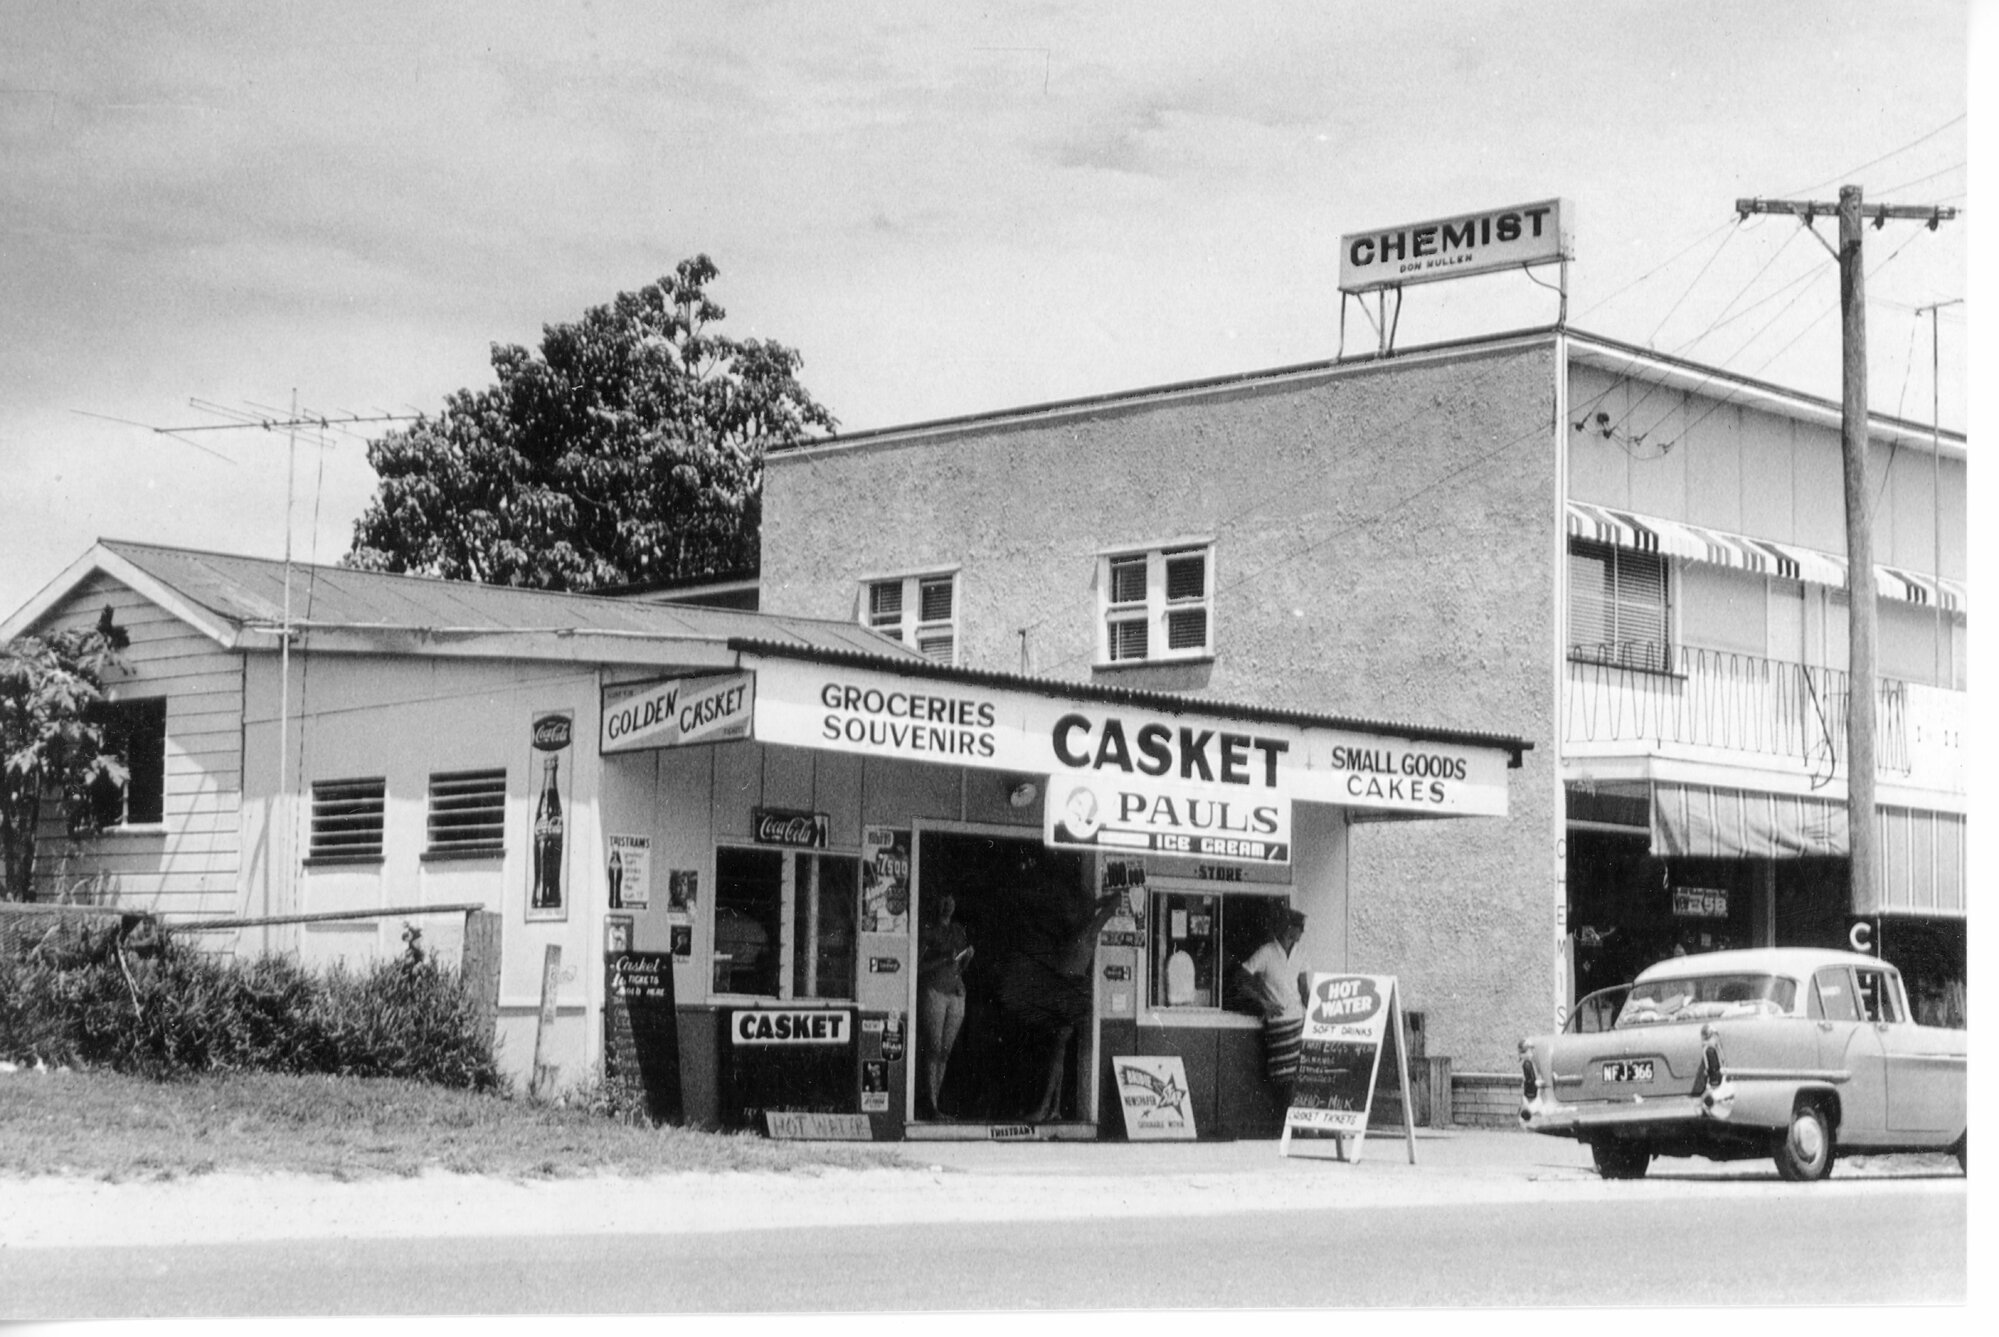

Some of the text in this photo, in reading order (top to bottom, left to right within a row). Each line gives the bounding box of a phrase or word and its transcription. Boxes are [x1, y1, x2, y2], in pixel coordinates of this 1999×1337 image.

[1350, 207, 1550, 267] CHEMIST
[1400, 262, 1422, 273] DON
[608, 684, 746, 740] GOLDEN CASKET
[821, 682, 995, 728] GROCERIES
[535, 722, 569, 743] Coca-Cola
[822, 715, 996, 758] SOUVENIRS
[1052, 713, 1290, 788] CASKET
[1346, 774, 1446, 803] CAKES
[1118, 792, 1279, 834] PAULS
[760, 814, 812, 843] Coca-Cola
[1156, 834, 1265, 858] ICE CREAM
[1200, 866, 1242, 881] STORE
[615, 955, 660, 973] Casket
[1328, 980, 1361, 1000] HOT
[1321, 995, 1372, 1018] WATER
[739, 1014, 844, 1040] CASKET
[1312, 1025, 1373, 1037] SOFT DRINKS
